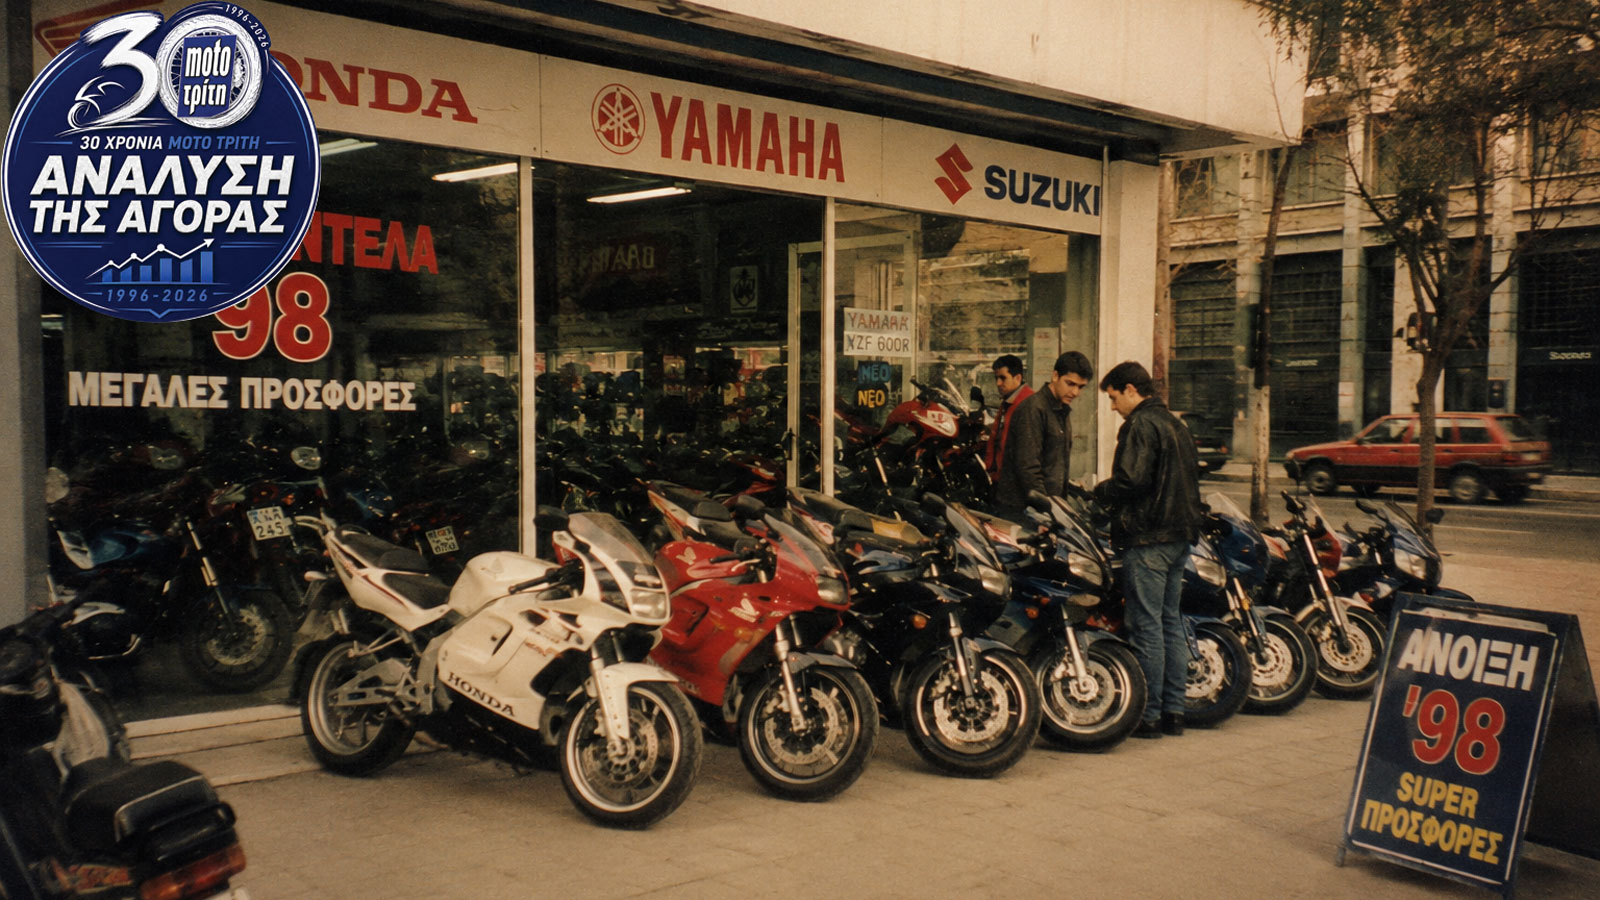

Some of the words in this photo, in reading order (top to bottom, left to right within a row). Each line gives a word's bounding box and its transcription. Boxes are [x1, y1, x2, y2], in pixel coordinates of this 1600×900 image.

[650, 92, 845, 183] YAMAHA
[983, 164, 1100, 216] SUZUKI
[291, 211, 439, 275] ΝΤΕΛΑ
[212, 271, 332, 363] 98
[878, 336, 909, 353] 600R
[68, 371, 229, 409] ΜΕΓΑΛΕΣ
[241, 377, 417, 412] ΠΡΟΣΦΟΡΕΣ
[1397, 628, 1539, 691] ΑΝΟΙΞΗ
[448, 671, 516, 717] HONDA
[1403, 684, 1506, 775] '98
[1397, 772, 1479, 819] SUPER
[1361, 799, 1504, 865] ΠΡΟΣΦΟΡΕΣ
